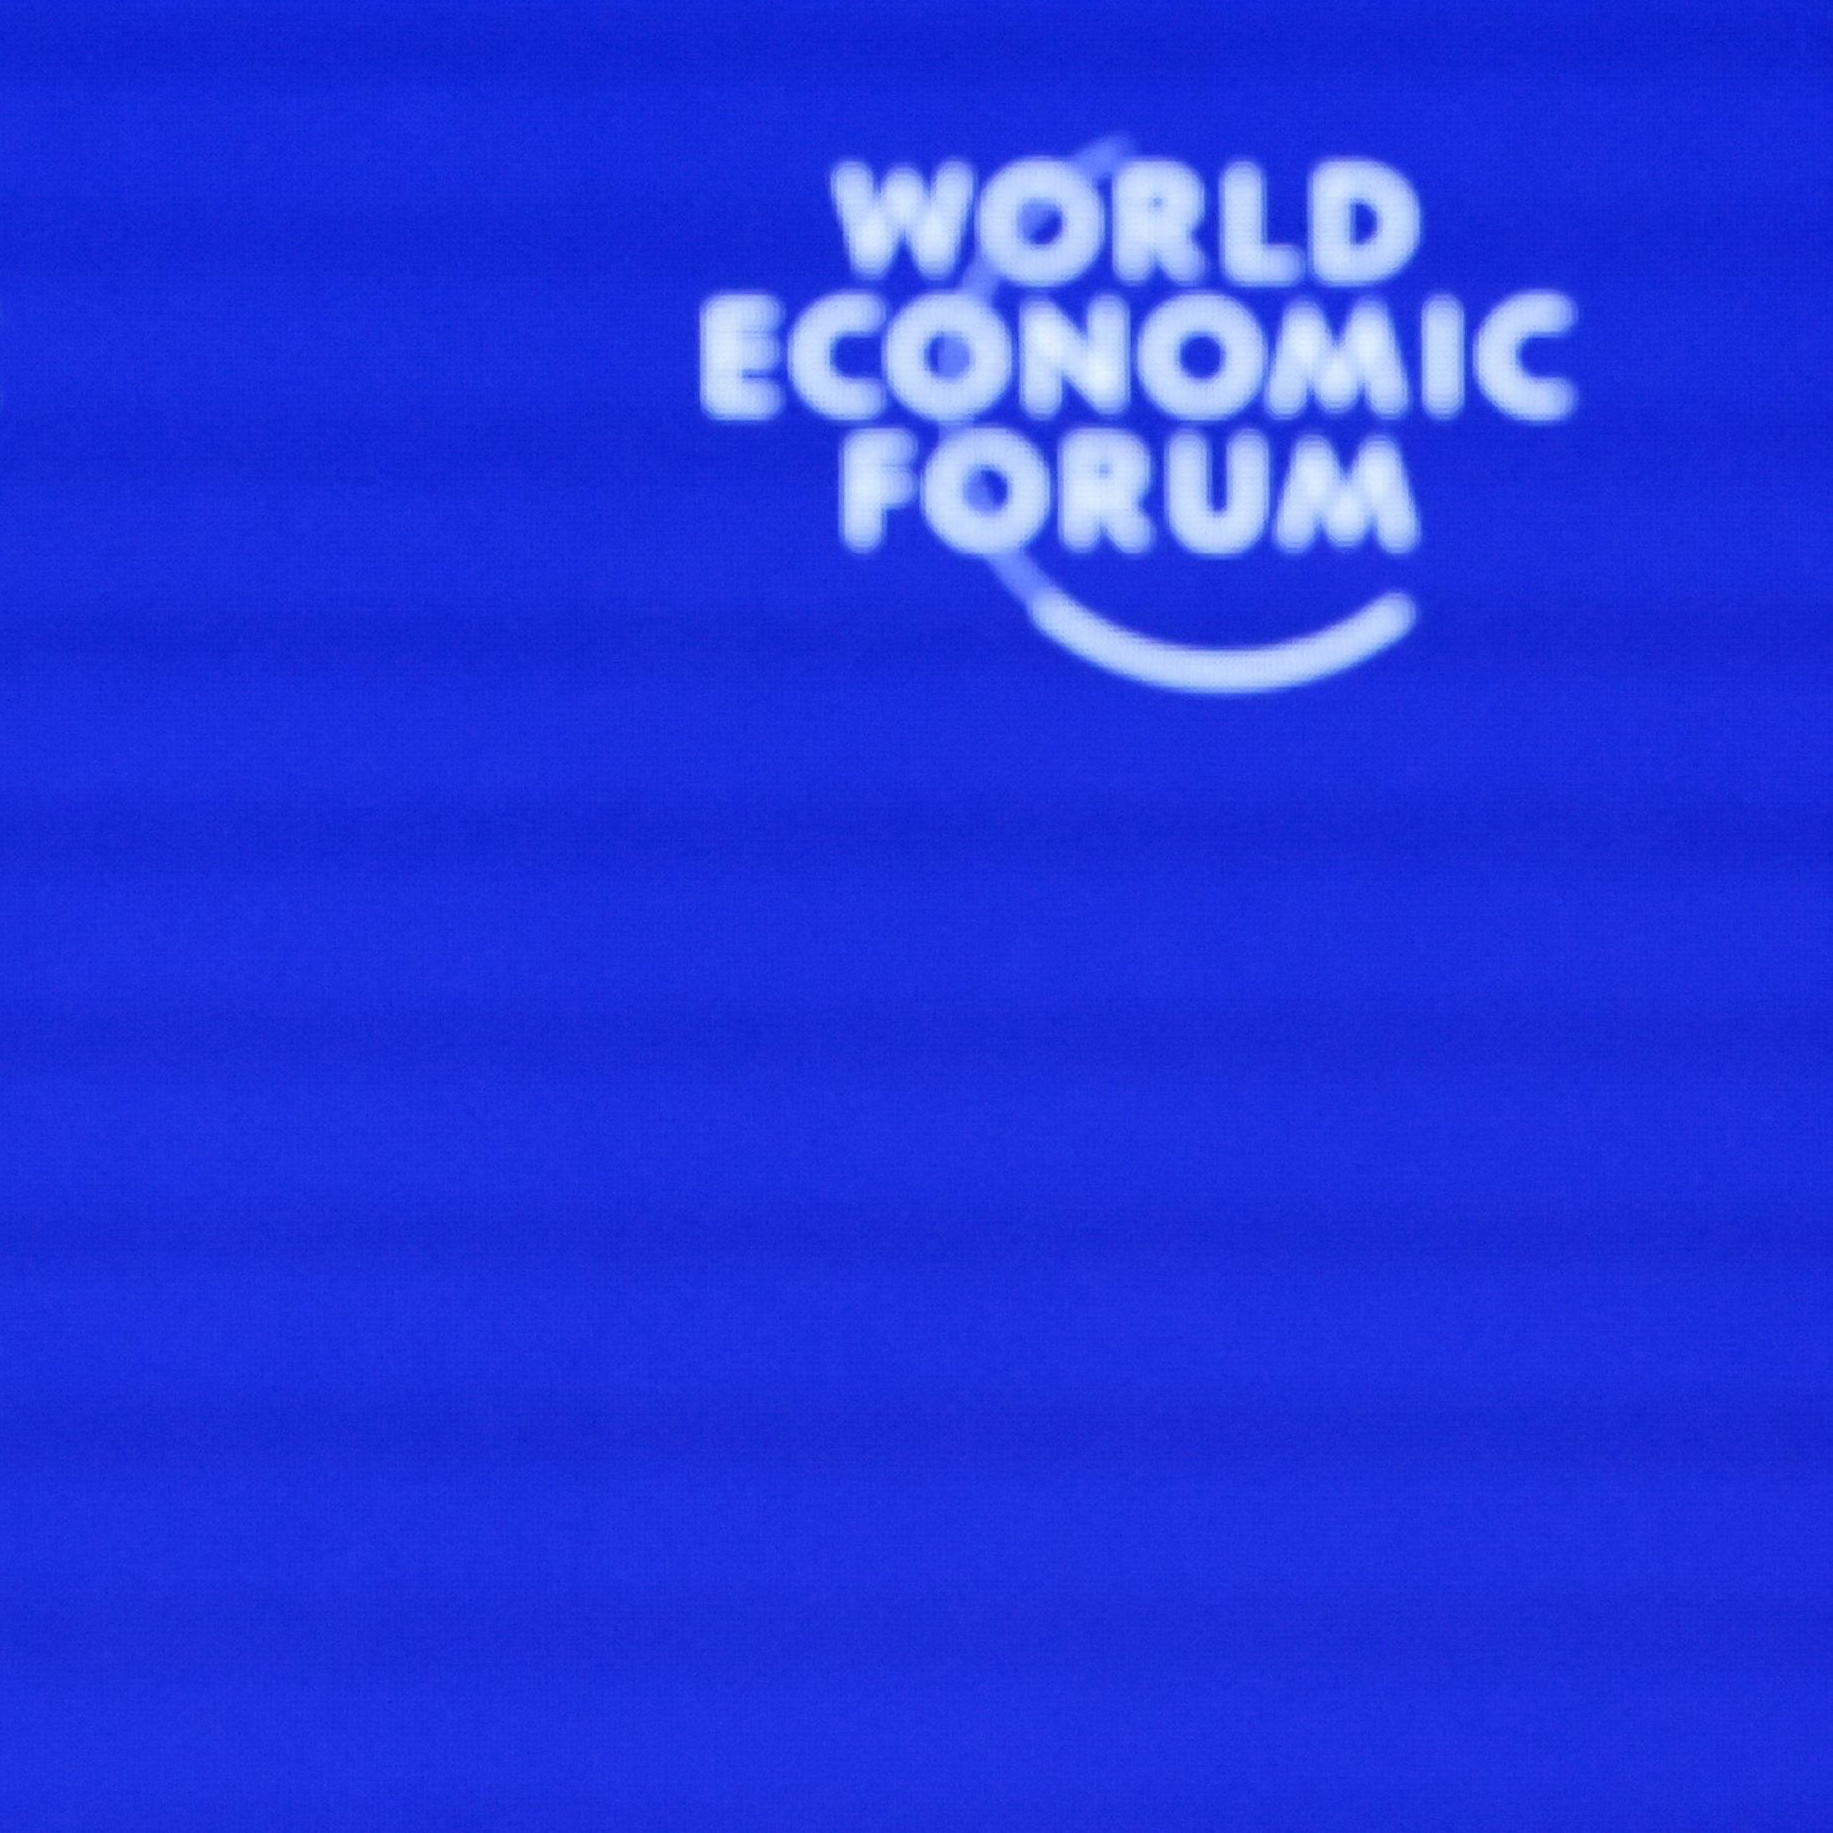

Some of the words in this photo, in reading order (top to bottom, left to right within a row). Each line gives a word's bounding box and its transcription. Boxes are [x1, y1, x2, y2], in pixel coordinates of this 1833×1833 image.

[832, 158, 1421, 288] WORLD
[698, 287, 1570, 423] ECONOMIC
[841, 426, 1418, 557] FORUM
